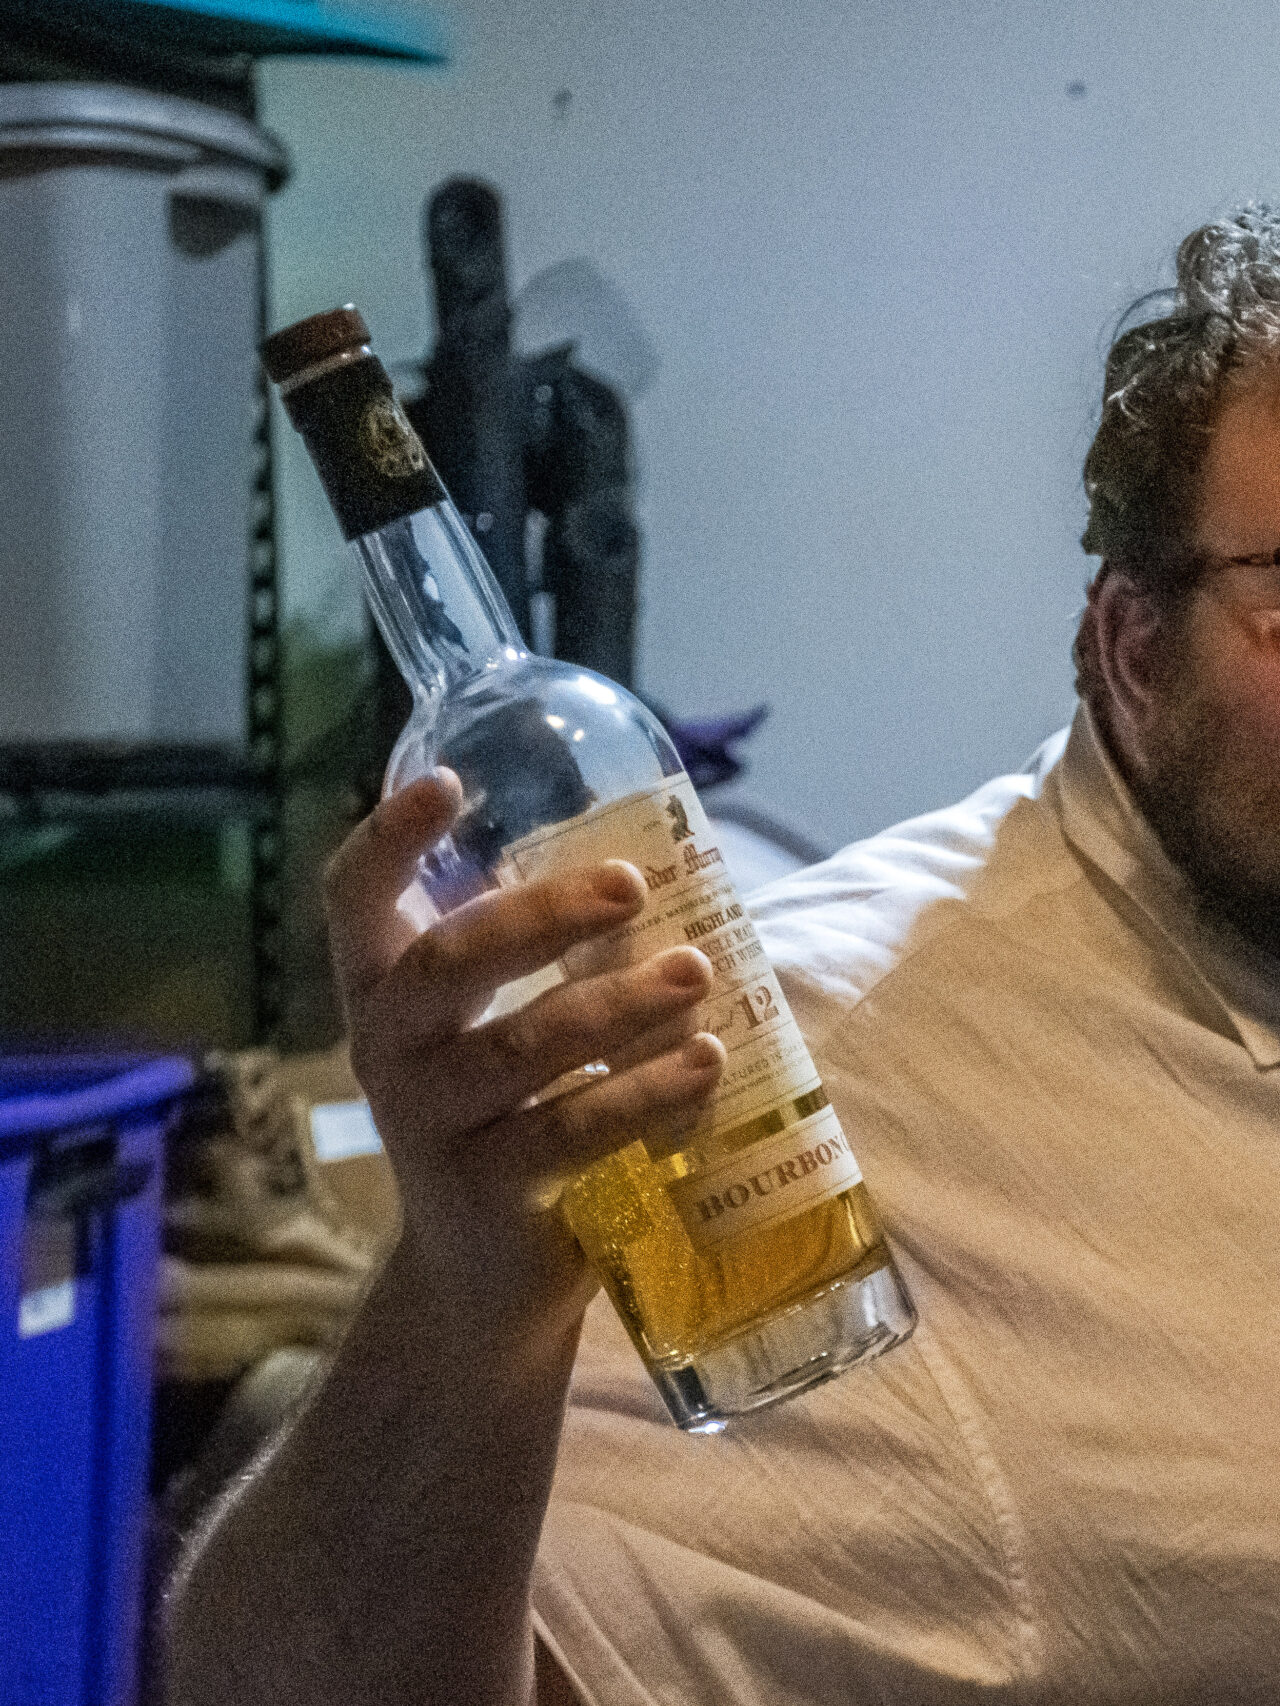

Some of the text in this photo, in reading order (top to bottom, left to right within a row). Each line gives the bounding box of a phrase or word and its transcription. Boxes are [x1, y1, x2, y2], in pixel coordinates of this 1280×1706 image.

[683, 903, 743, 941] HIGHLAND
[700, 933, 735, 958] NGLE
[735, 985, 780, 1029] 12
[719, 1057, 770, 1088] ATURED
[700, 1134, 845, 1222] BOURBON
